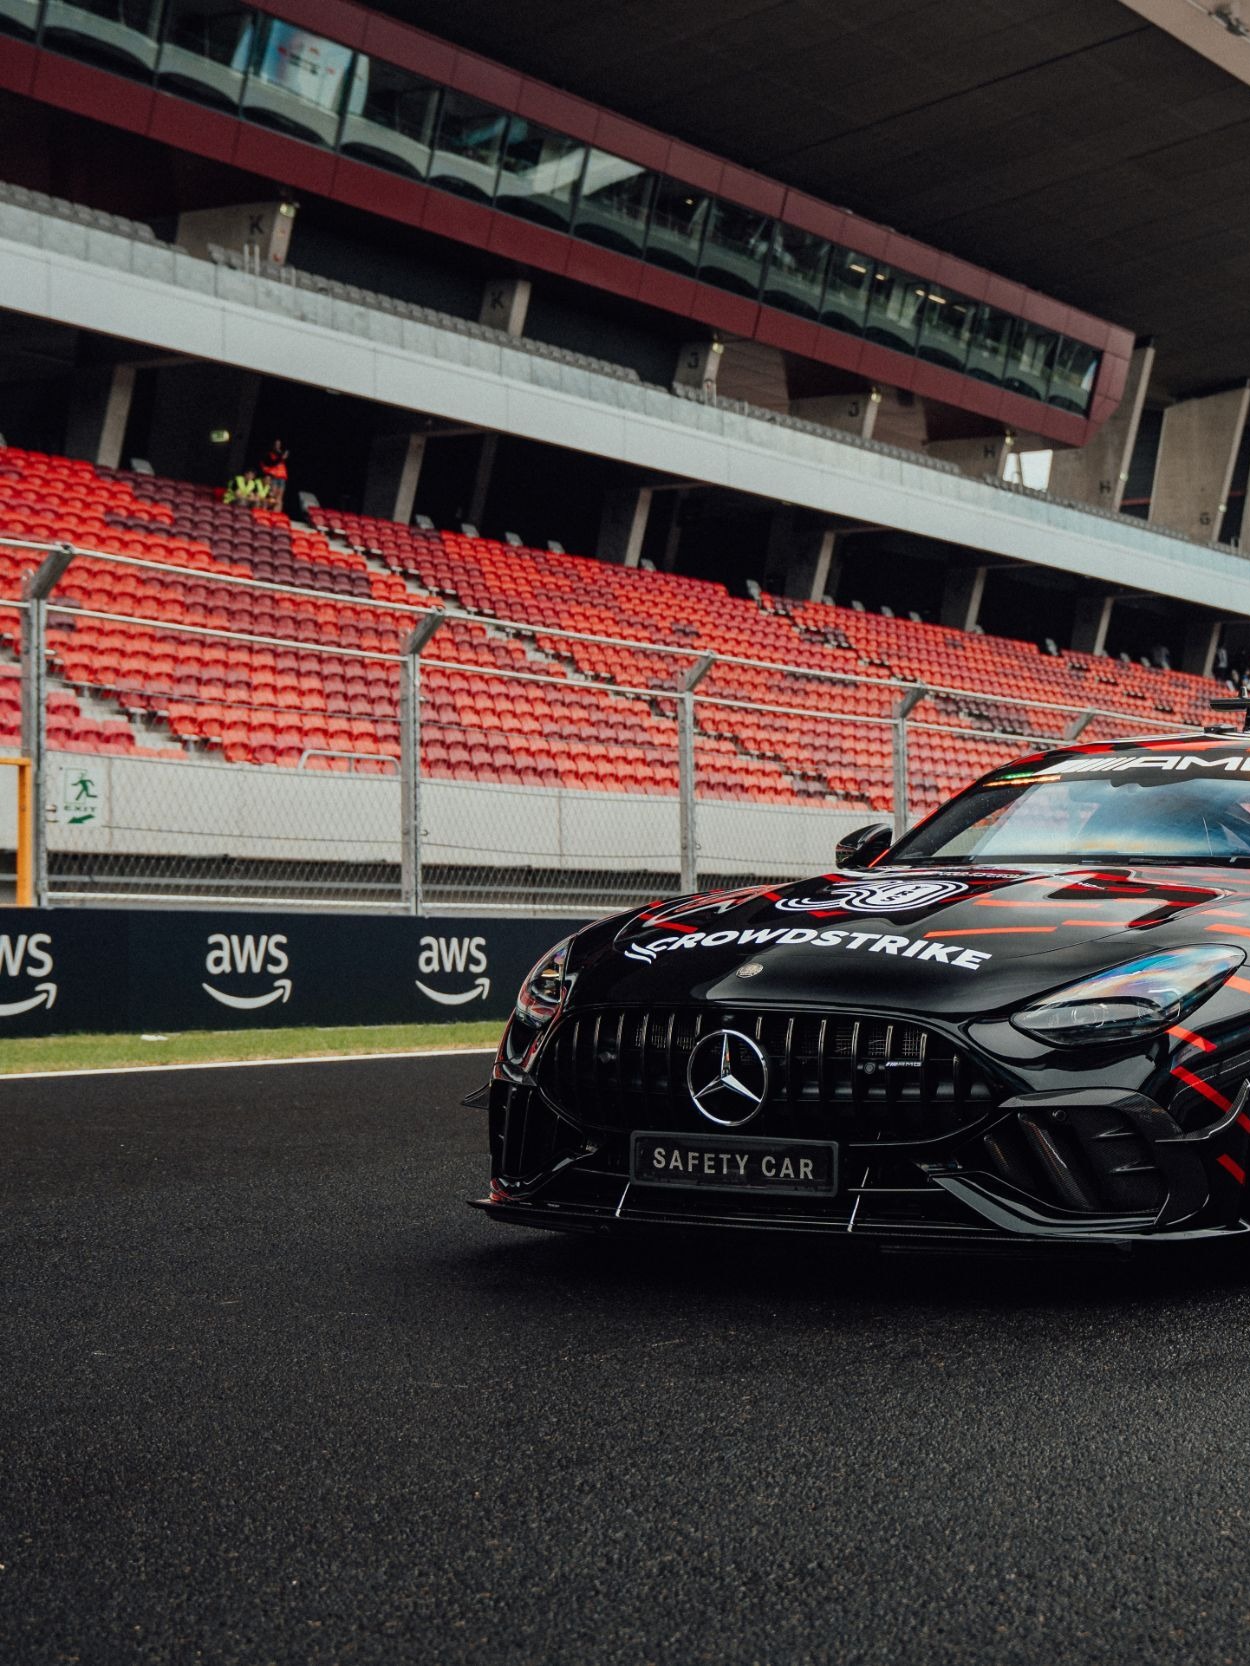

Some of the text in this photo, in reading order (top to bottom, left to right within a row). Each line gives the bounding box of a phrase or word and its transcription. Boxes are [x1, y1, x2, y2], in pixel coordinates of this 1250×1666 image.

[249, 214, 264, 235] K
[490, 290, 504, 311] K
[0, 933, 53, 978] ws
[206, 933, 289, 975] aws
[418, 935, 487, 974] aws
[645, 927, 992, 970] CROWDSTRIKE
[653, 1147, 814, 1180] SAFETY CAR
